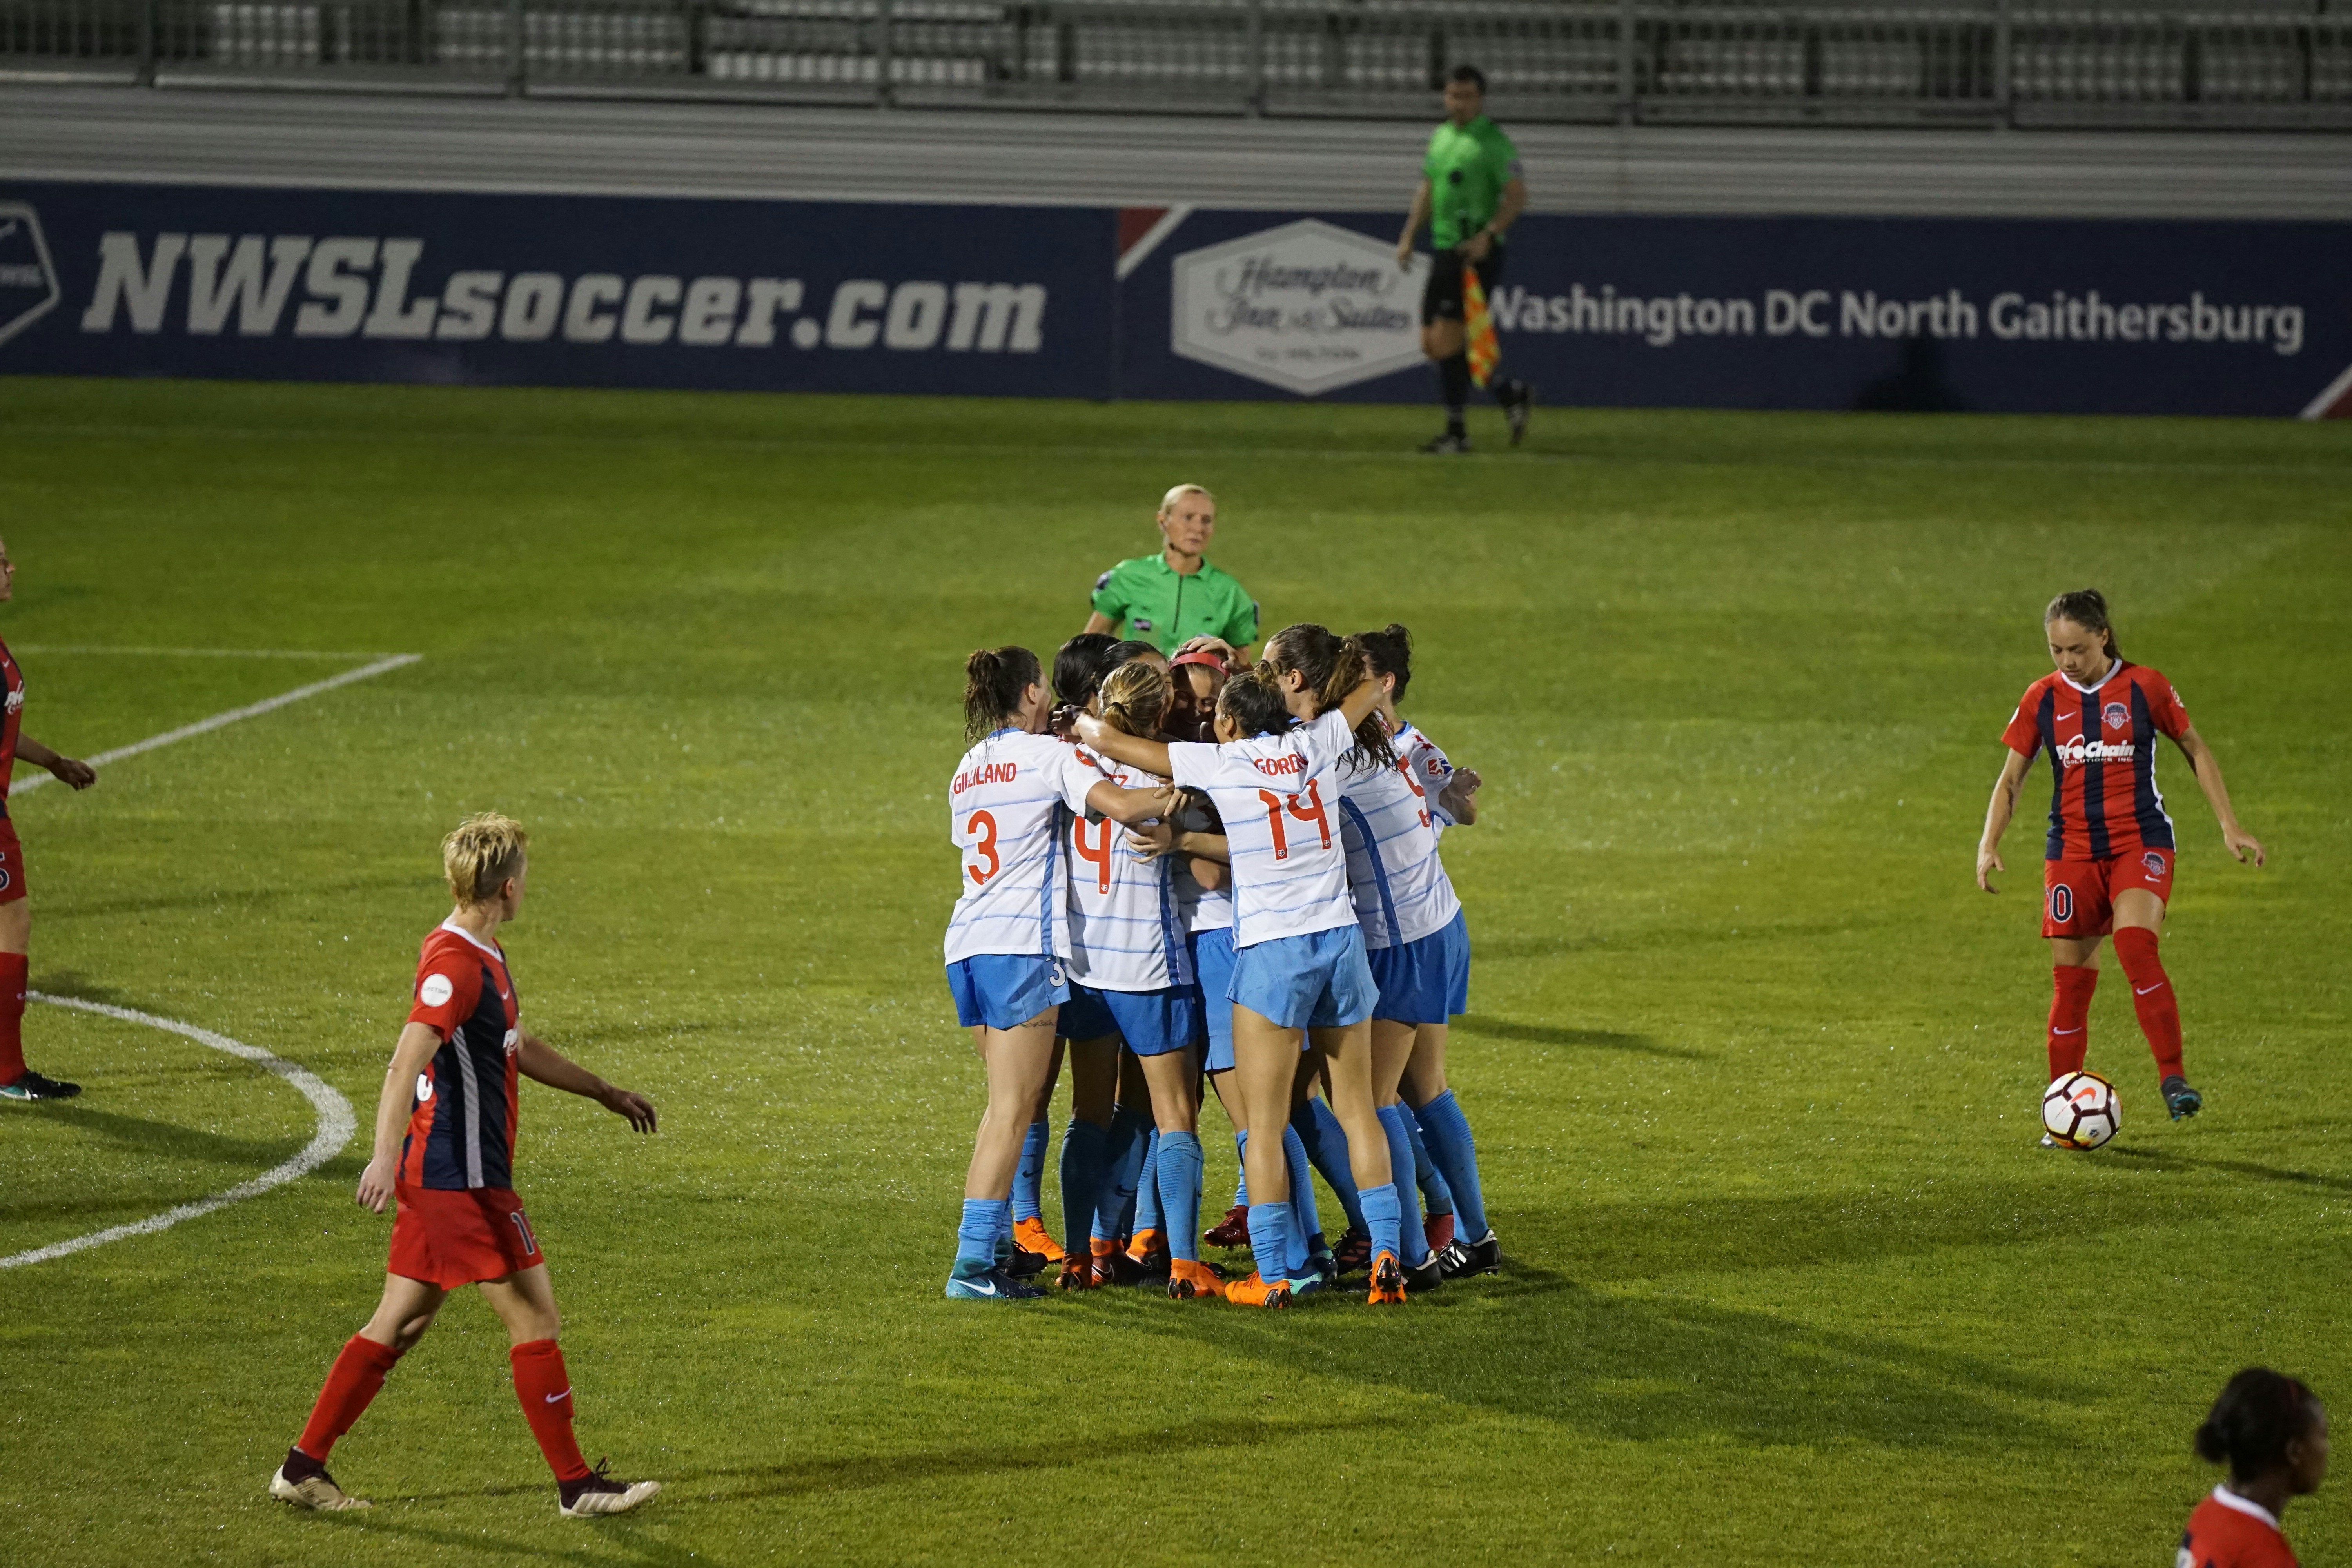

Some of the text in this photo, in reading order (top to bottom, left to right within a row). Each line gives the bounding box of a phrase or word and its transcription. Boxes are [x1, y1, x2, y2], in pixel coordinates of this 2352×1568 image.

[81, 233, 1047, 353] NWSLsoccer.com
[1218, 257, 1399, 299] Hampton
[1490, 283, 2304, 355] Washington DC North Gaithersburg
[967, 809, 1000, 886] 3
[1074, 814, 1112, 895] 4
[1258, 778, 1332, 861] 14
